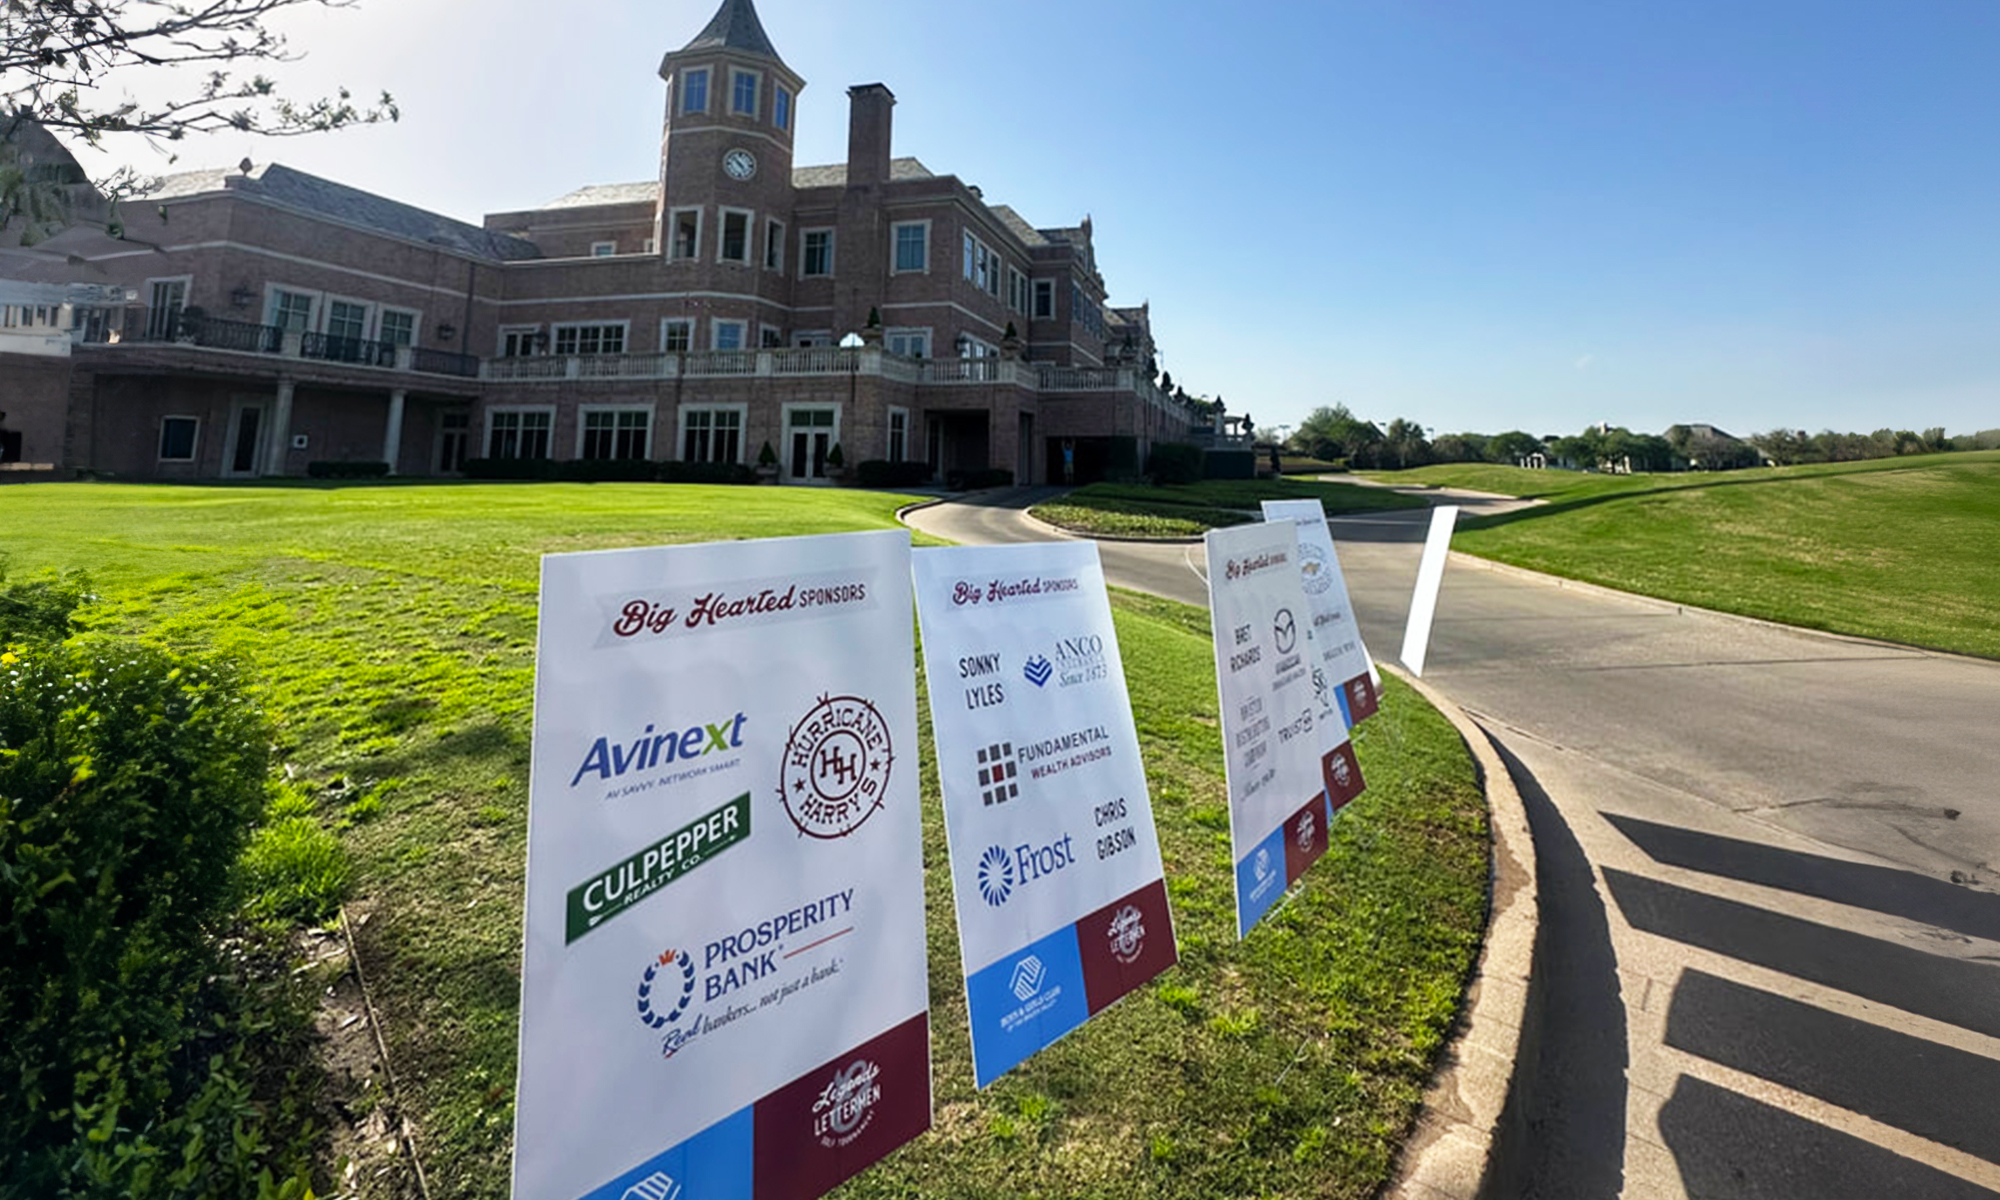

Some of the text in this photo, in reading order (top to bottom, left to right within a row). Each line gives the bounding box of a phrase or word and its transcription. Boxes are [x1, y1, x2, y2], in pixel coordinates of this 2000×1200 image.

[613, 583, 866, 637] Big Hearted SPONSORS
[952, 581, 982, 606] Big
[987, 577, 1040, 602] Hearted
[958, 652, 1000, 679] SONNY
[1055, 633, 1103, 661] ANCO
[965, 682, 1005, 710] LYLES
[570, 712, 748, 787] Avinext
[790, 707, 883, 769] HURRICANE
[1017, 725, 1110, 764] FUNDAMENTAL
[583, 805, 739, 912] CULPEPPER
[1014, 832, 1076, 886] Frost
[624, 867, 675, 905] REALTY
[704, 887, 854, 970] PROSPERITY
[704, 948, 778, 1003] BANK
[662, 1012, 703, 1057] Real
